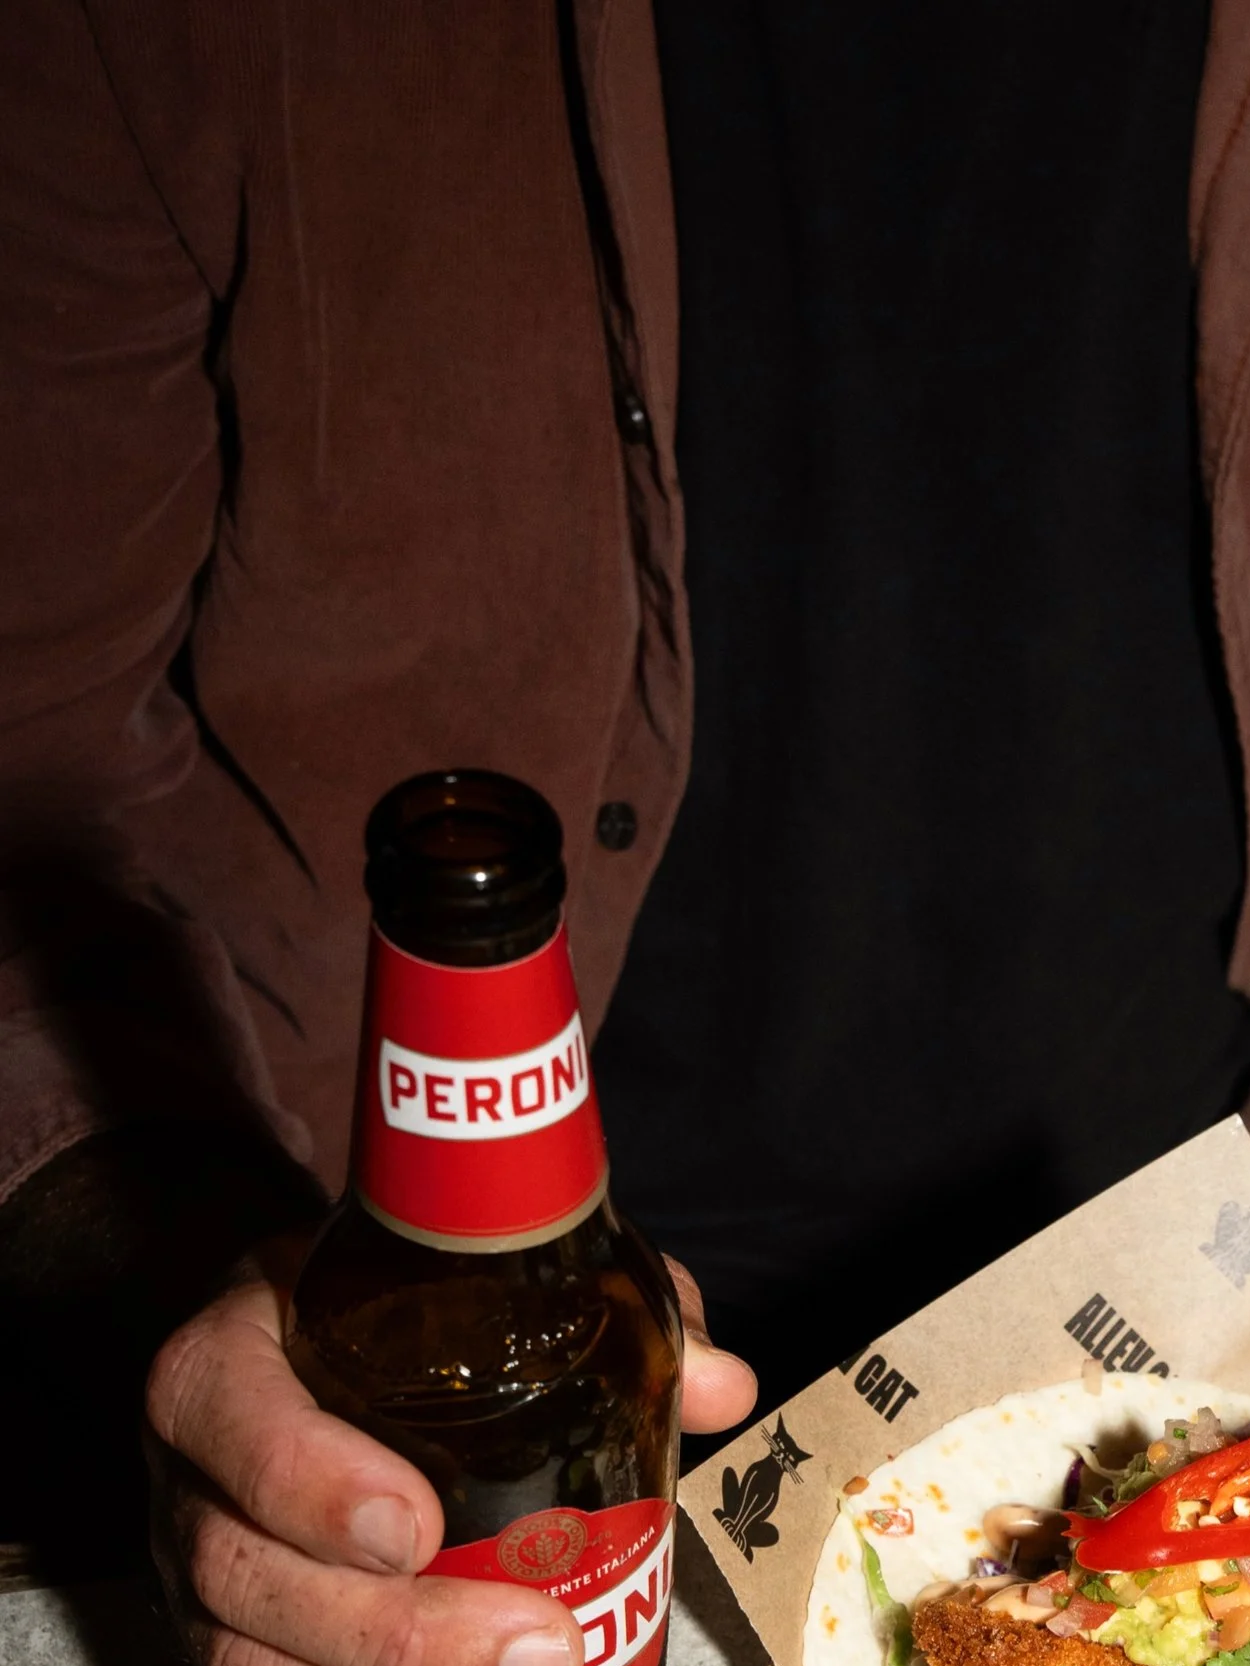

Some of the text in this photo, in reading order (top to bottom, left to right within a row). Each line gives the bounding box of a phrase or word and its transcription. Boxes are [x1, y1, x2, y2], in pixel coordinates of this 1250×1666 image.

[388, 1032, 584, 1123] PERONI
[854, 1353, 920, 1424] CAT
[544, 1573, 592, 1598] ENTE
[596, 1525, 656, 1579] ITALIANA
